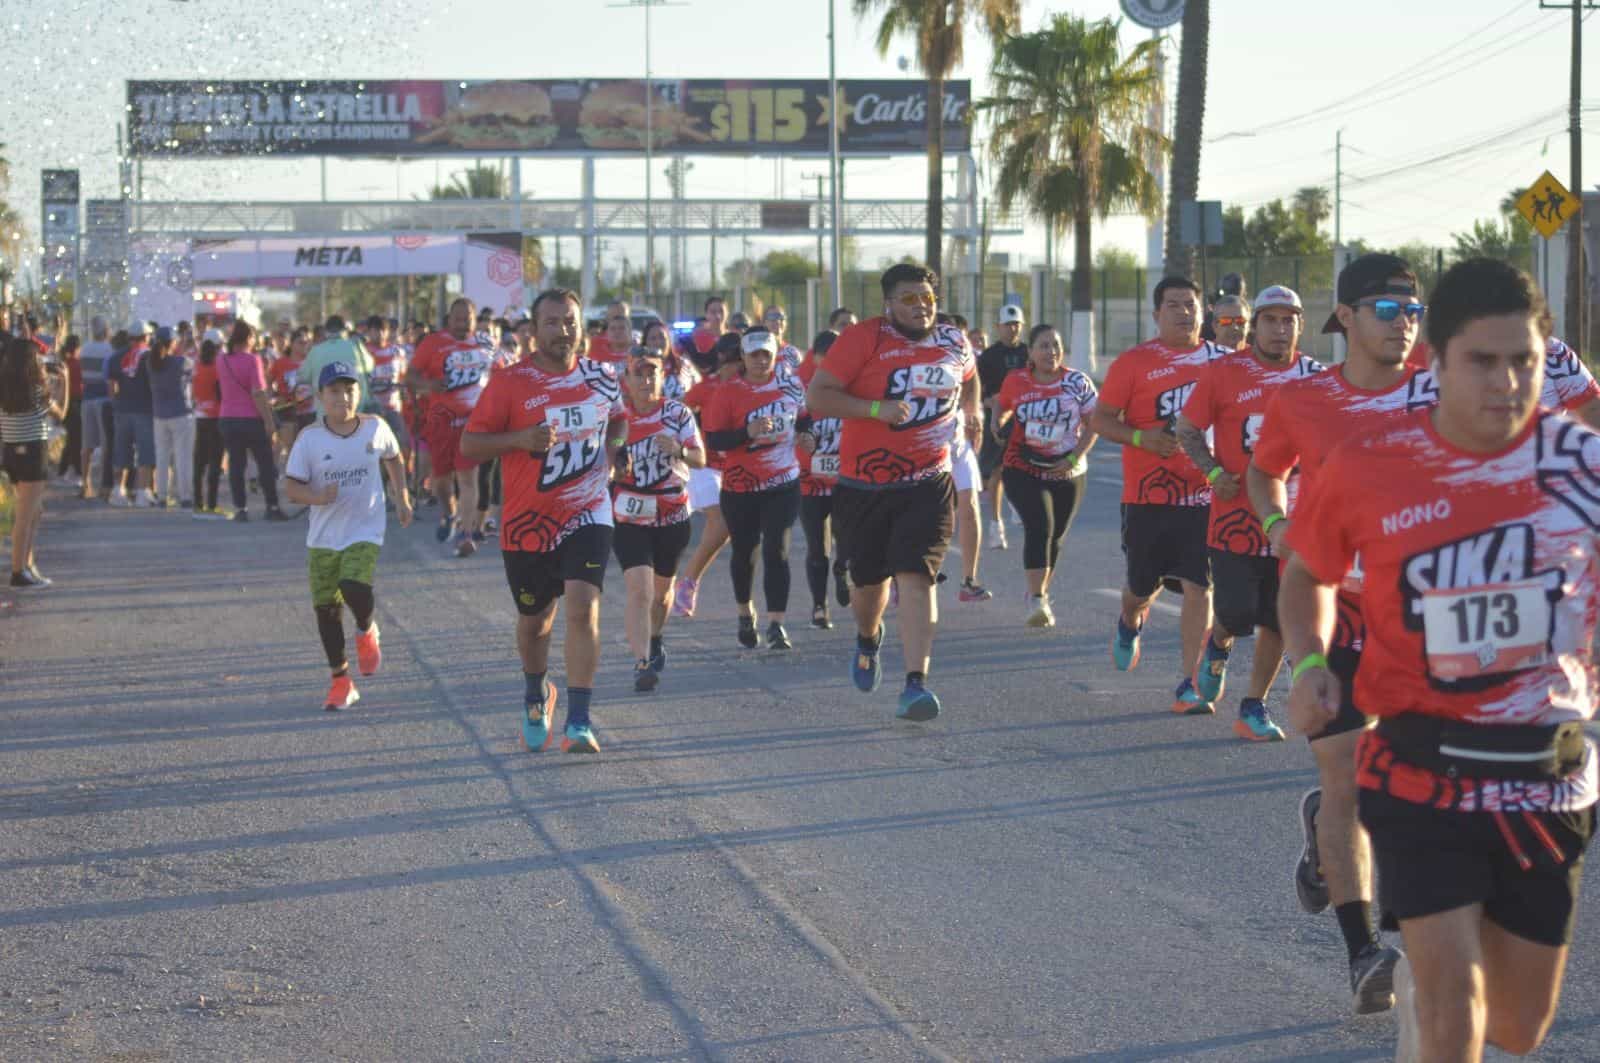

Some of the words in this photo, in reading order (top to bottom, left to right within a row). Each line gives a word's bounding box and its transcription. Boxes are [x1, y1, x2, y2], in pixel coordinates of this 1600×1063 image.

[250, 94, 285, 122] LA
[288, 94, 421, 122] ESTRELLA
[710, 88, 807, 142] $115
[853, 93, 926, 125] Carl's
[293, 246, 363, 267] META
[925, 366, 945, 386] 22
[560, 406, 583, 427] 75
[625, 497, 644, 515] 97
[1382, 498, 1451, 536] NONO
[1406, 525, 1528, 595] SIKA
[1448, 592, 1519, 644] 173
